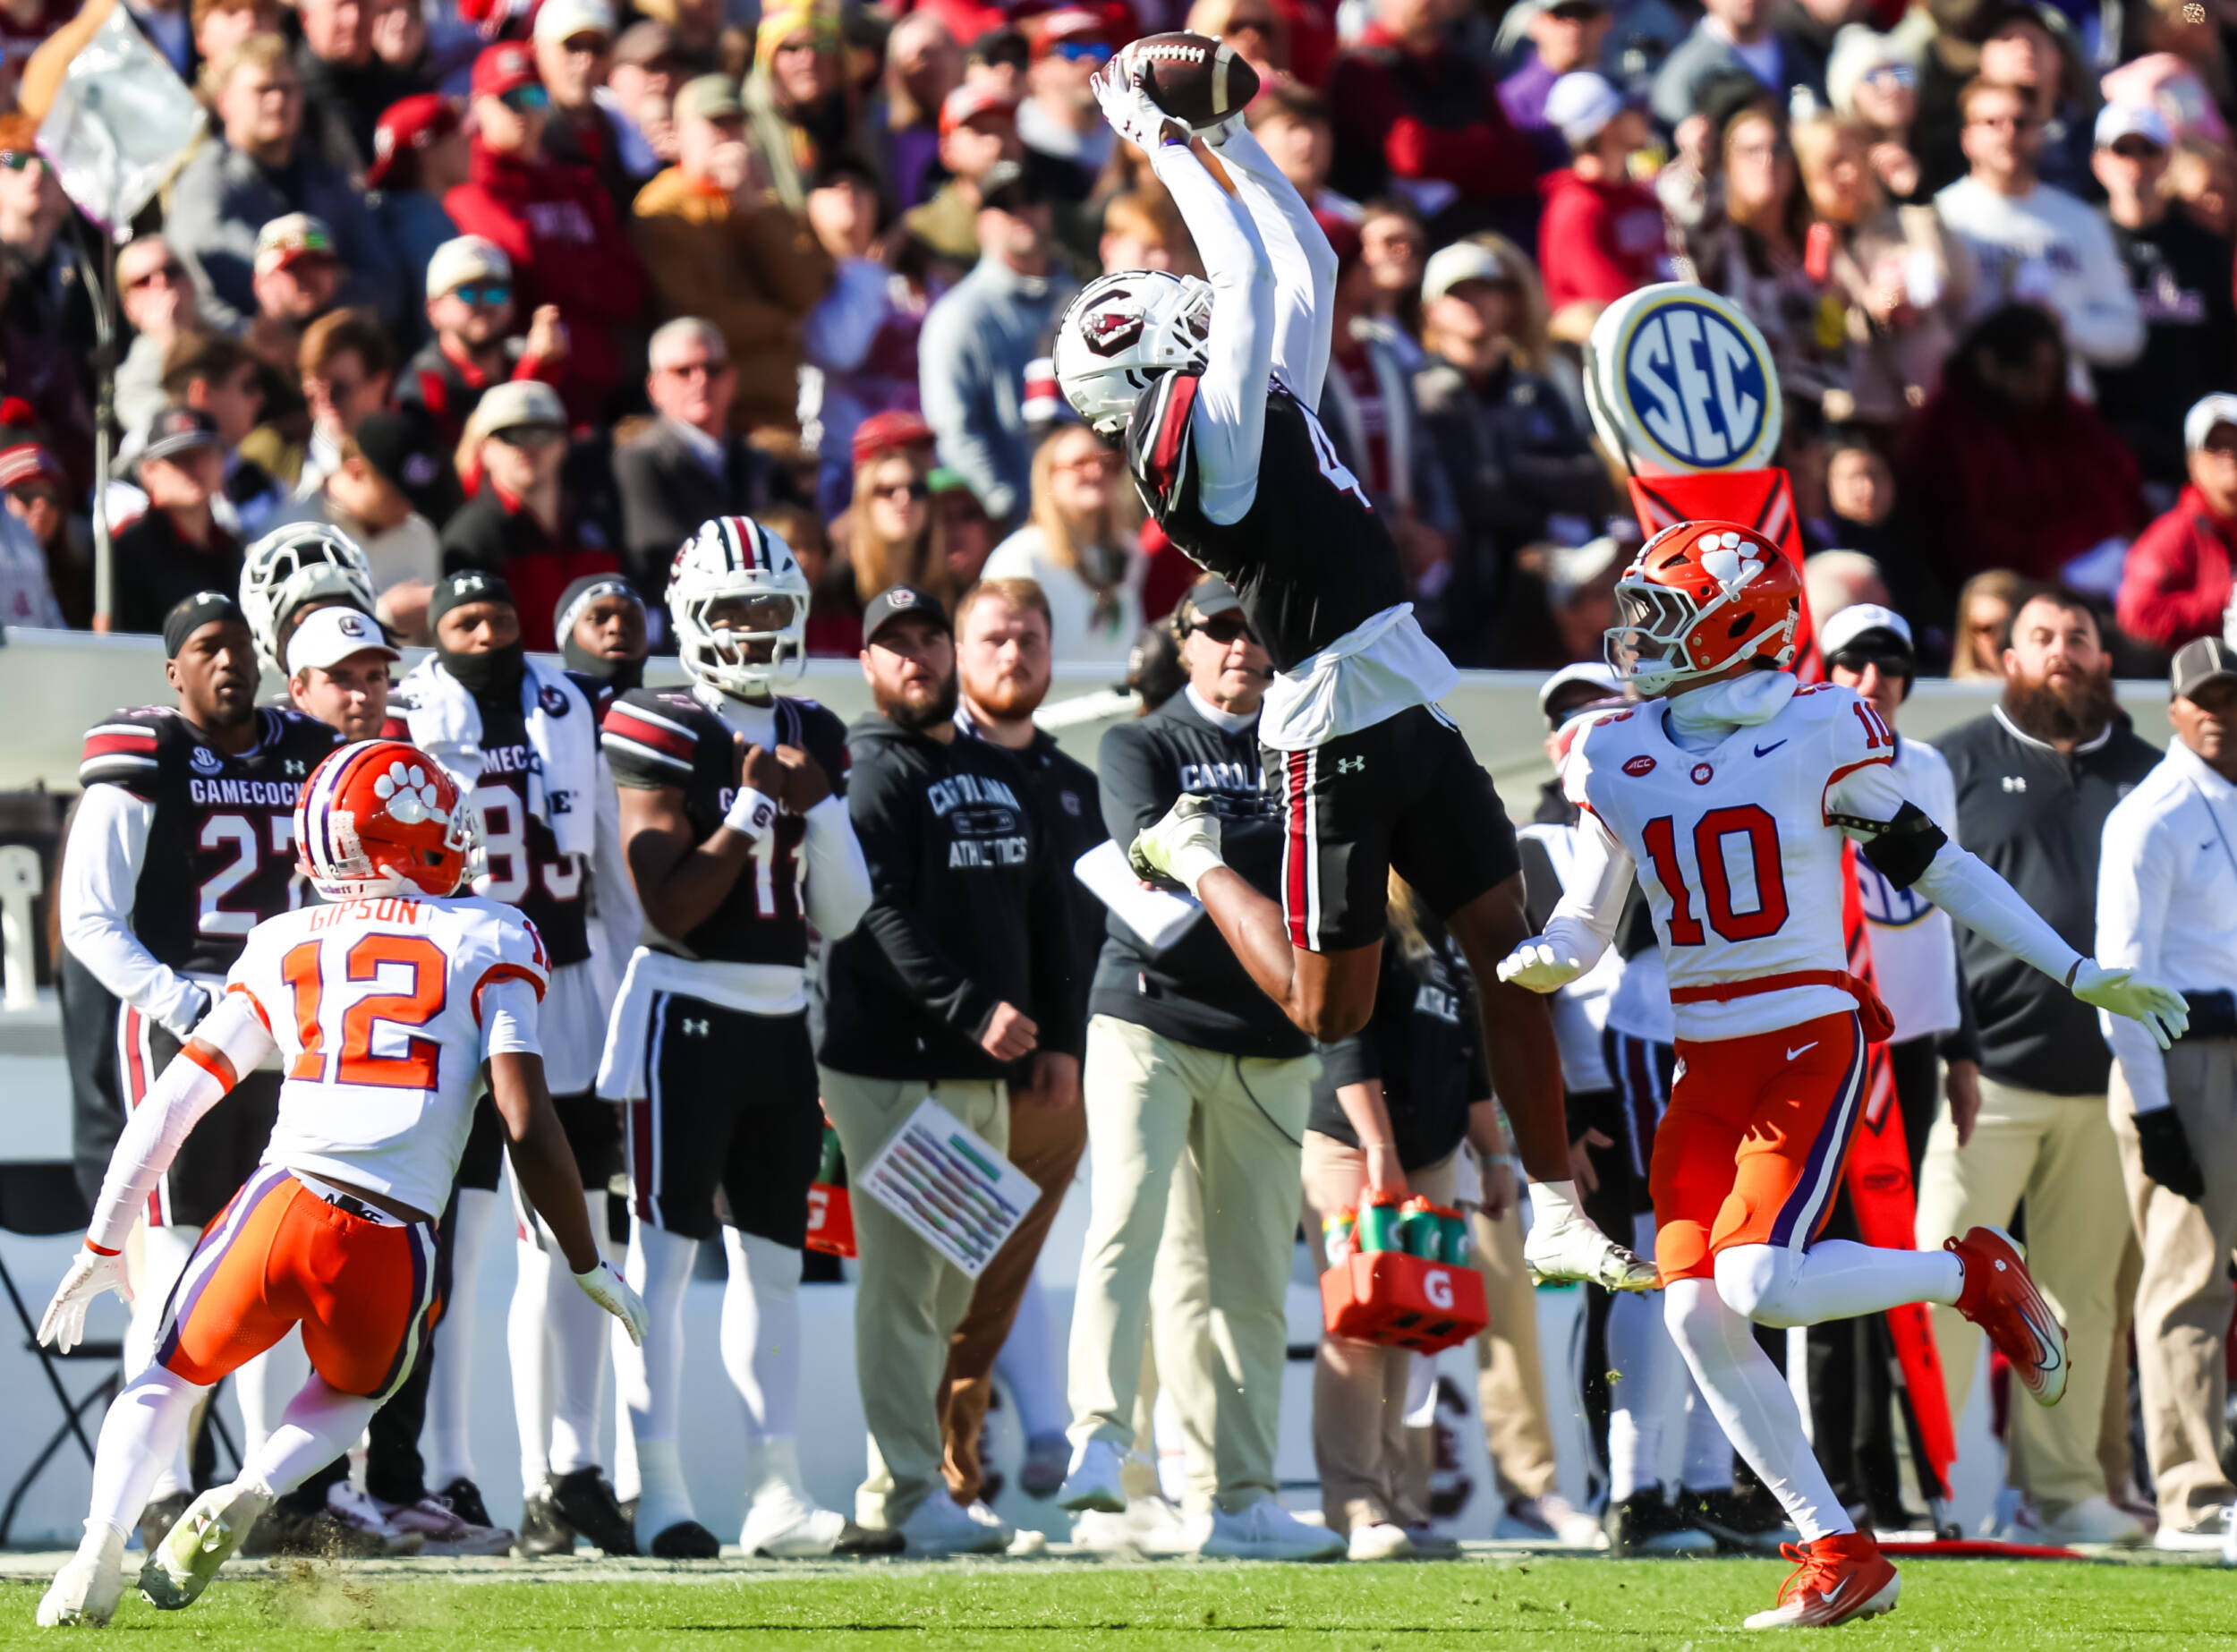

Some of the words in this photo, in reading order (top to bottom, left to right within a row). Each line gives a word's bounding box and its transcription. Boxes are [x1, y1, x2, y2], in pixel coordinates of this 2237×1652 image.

[1629, 309, 1759, 460] SEC
[1295, 401, 1373, 514] 4
[1628, 757, 1652, 771] ACC
[310, 898, 421, 932] GIPSON
[1641, 803, 1790, 947] 10
[281, 932, 447, 1093] 12
[1424, 1270, 1453, 1309] G
